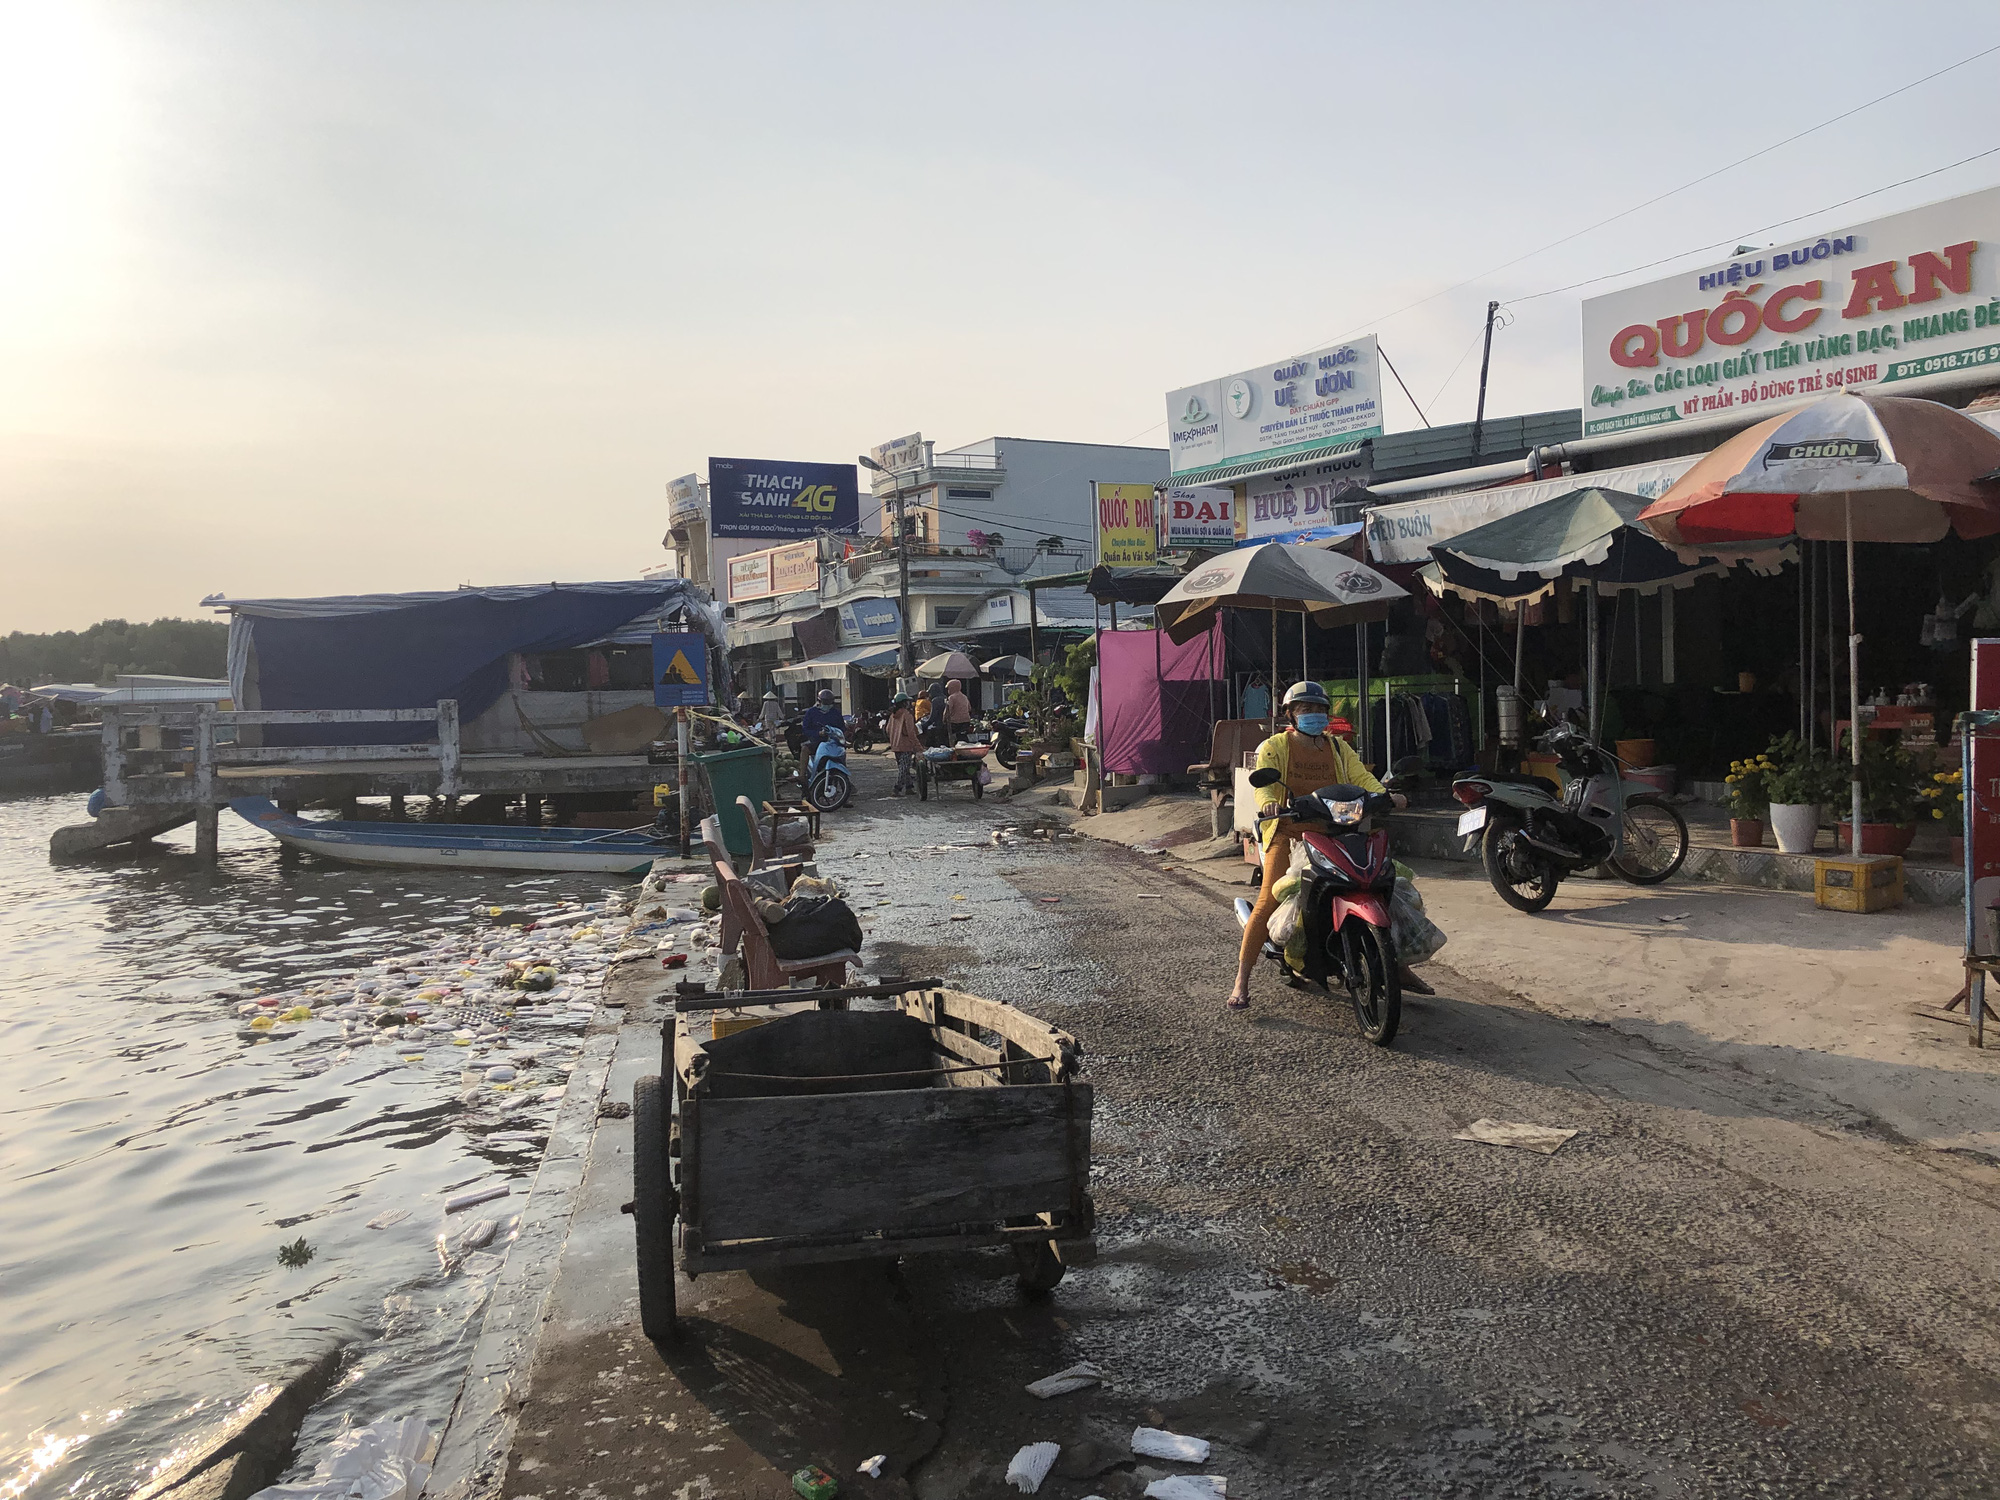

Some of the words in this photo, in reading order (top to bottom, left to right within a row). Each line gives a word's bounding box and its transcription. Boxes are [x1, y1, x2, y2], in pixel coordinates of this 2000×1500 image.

[1699, 260, 1763, 291] HIỆU
[1773, 235, 1854, 271] BUÔN
[1610, 280, 1822, 368] QUỐC
[1842, 241, 1978, 319] AN
[1654, 367, 1684, 393] CÁC
[1687, 362, 1719, 387] LOẠI
[1722, 349, 1758, 379] GIẤY
[1763, 340, 1801, 370] TIỀN
[1805, 334, 1851, 362] VÀNG
[1903, 308, 1969, 342] NHANG
[1897, 363, 1921, 377] ĐT:
[1924, 349, 1986, 372] 0918.716
[1990, 347, 2000, 361] 9
[1273, 359, 1307, 382] QUẦY
[1326, 397, 1340, 407] GPP
[1684, 395, 1699, 415] MỸ
[1702, 386, 1733, 411] PHẨM
[1741, 380, 1758, 404] ĐỒ
[1760, 380, 1795, 401] DÙNG
[1798, 368, 1822, 394] TRẺ
[1848, 363, 1878, 385] SINH
[1260, 420, 1285, 434] CHUYÊN
[1285, 417, 1298, 428] BÁN
[1308, 409, 1330, 423] THUỐC
[1331, 405, 1354, 418] THÀNH
[1355, 398, 1376, 412] PHẨM
[747, 474, 804, 491] THẠCH
[1172, 491, 1196, 500] Shop
[740, 491, 791, 507] SANH
[791, 484, 838, 513] 4G
[1100, 487, 1129, 533] QUỐC
[1135, 499, 1154, 534] ĐẠI
[1173, 501, 1230, 523] ĐẠI
[1253, 483, 1298, 524] HUỆ
[1397, 509, 1433, 539] BUÔN
[1122, 548, 1132, 562] Áo
